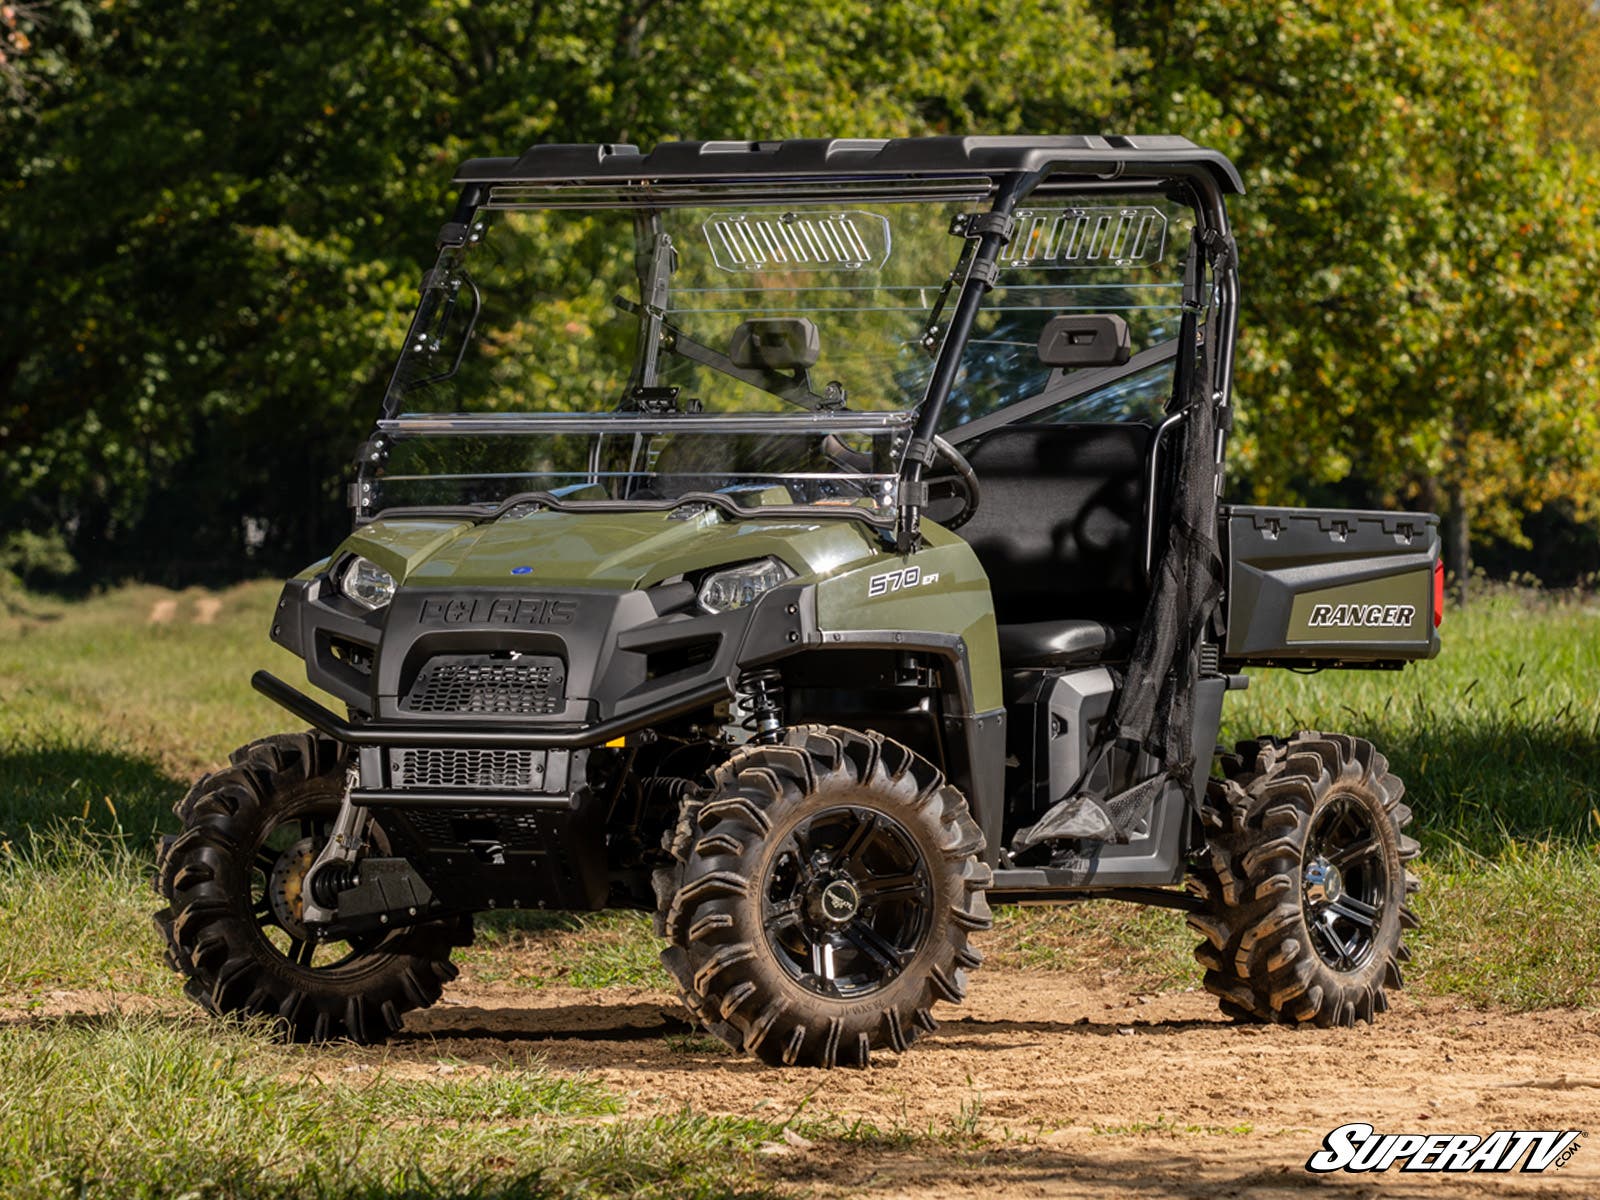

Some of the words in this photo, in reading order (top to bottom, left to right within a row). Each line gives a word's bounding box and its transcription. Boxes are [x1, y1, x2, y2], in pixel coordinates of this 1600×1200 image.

[868, 566, 920, 597] 570
[419, 598, 578, 625] POLARIS
[1308, 604, 1415, 627] RANGER
